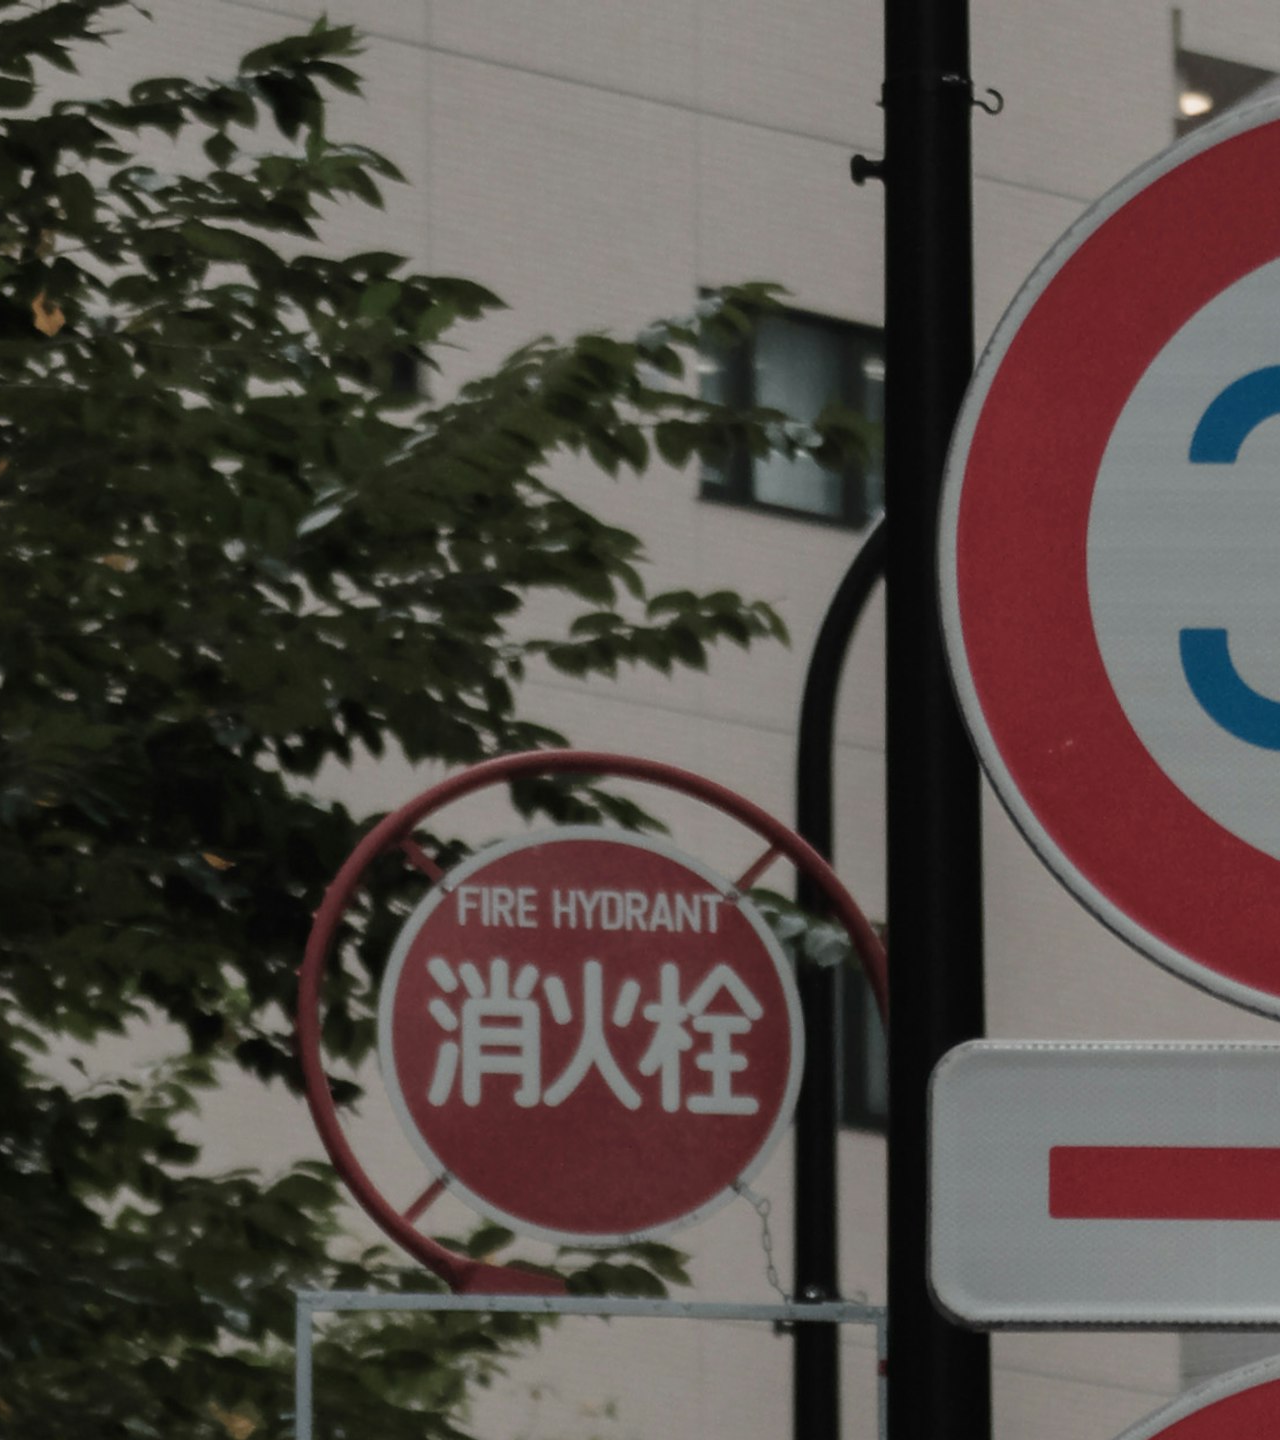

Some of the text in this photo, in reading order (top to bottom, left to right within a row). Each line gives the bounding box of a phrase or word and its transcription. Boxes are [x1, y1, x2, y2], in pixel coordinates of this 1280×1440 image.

[456, 886, 723, 934] FIRE HYDRANT
[426, 957, 765, 1116] 消火栓
